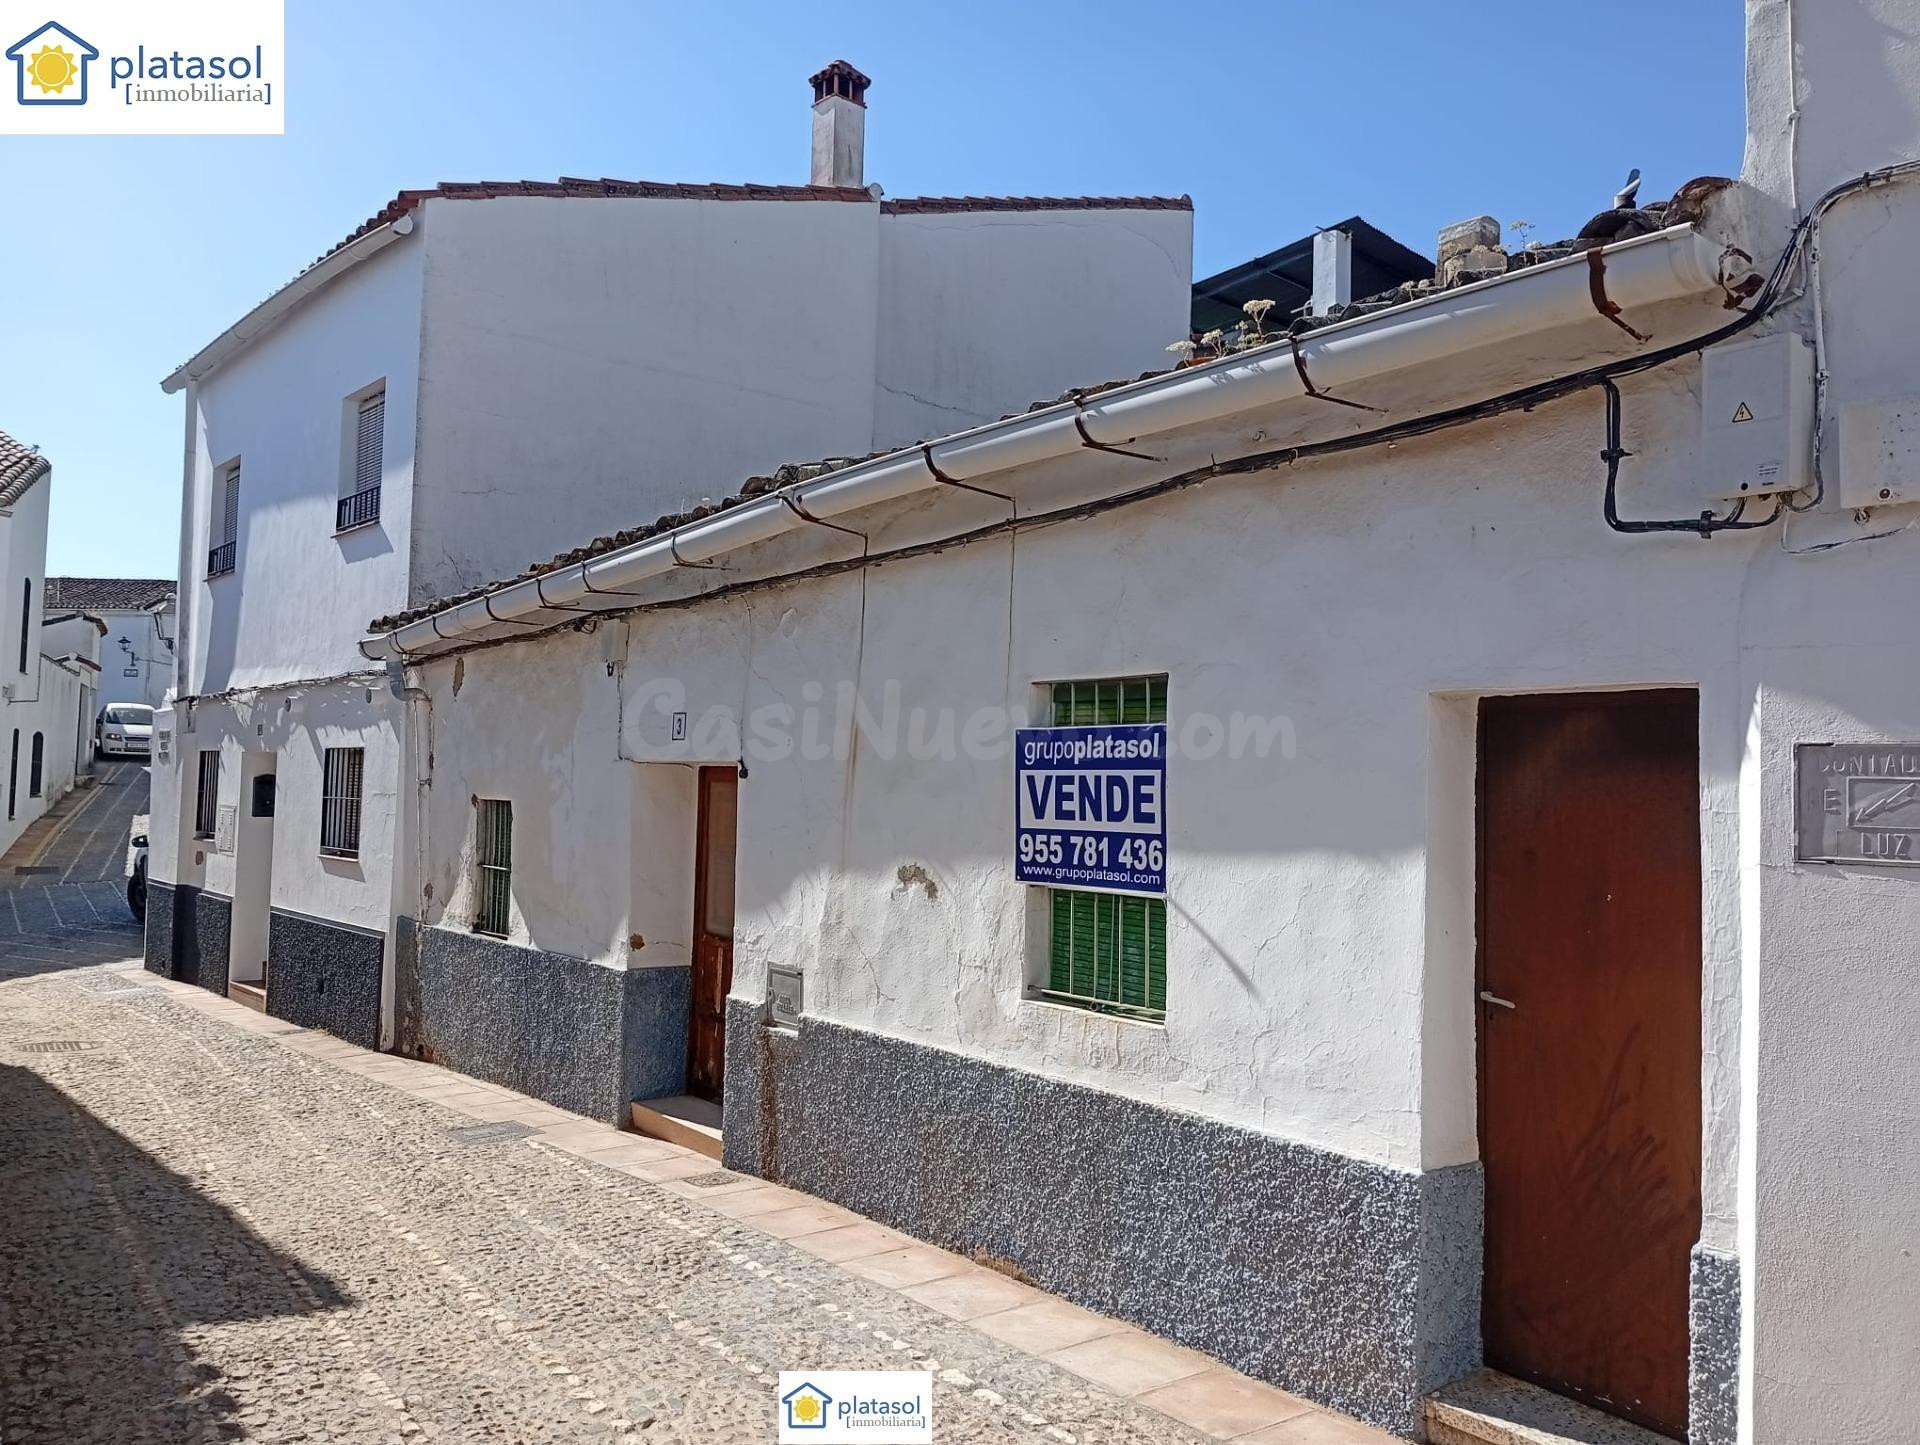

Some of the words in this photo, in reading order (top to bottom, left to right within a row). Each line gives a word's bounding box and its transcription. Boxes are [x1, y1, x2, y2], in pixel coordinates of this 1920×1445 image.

[676, 717, 683, 736] 3
[1023, 732, 1161, 766] grupoplatasol
[1025, 774, 1156, 824] VENDE
[1019, 833, 1064, 865] 955
[1069, 835, 1109, 867] 781
[1118, 838, 1164, 872] 436
[1860, 832, 1909, 857] LUZ
[1023, 864, 1161, 885] www.grupoplatasol.com
